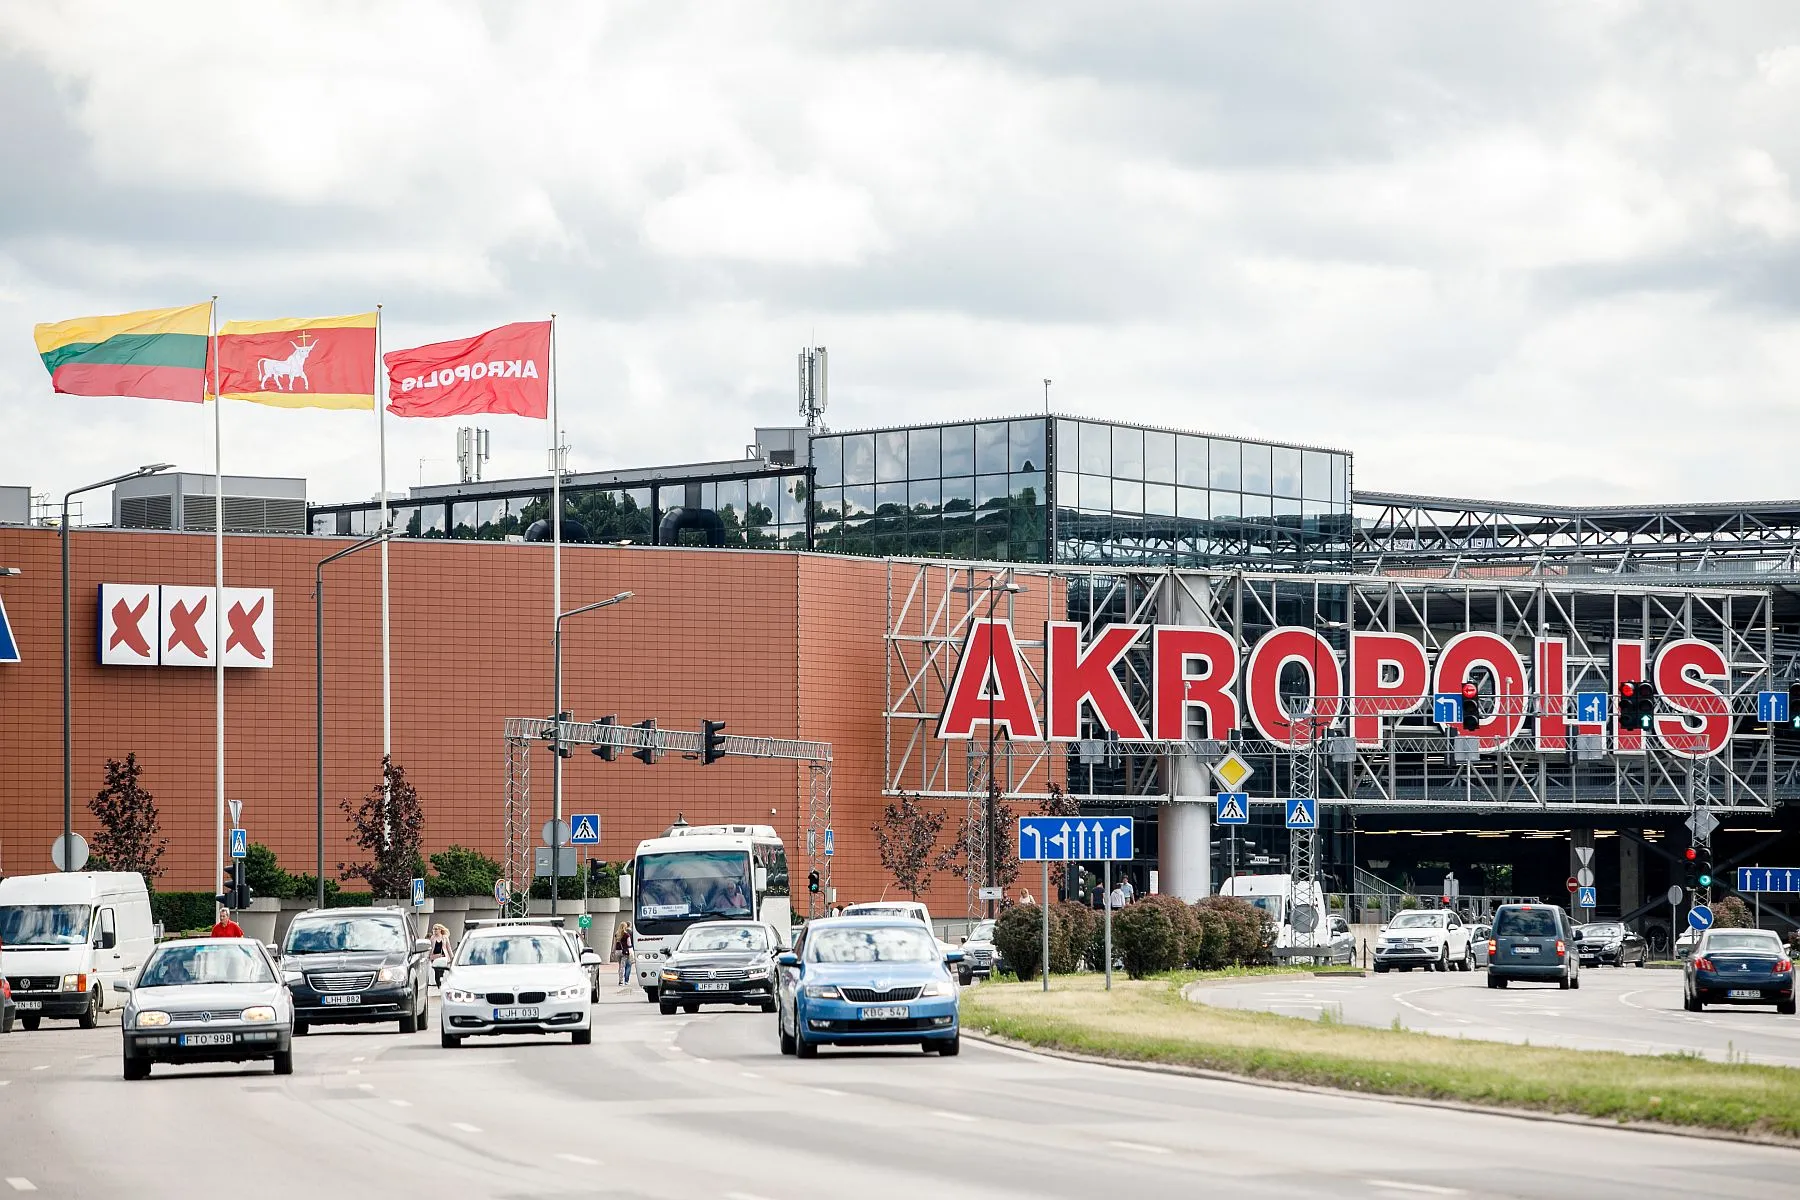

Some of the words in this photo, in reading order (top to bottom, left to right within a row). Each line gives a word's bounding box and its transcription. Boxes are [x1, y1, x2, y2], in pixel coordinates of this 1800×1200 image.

[936, 616, 1734, 759] AKROPOLIS
[325, 995, 342, 1004] LHH
[346, 995, 360, 1003] 882
[498, 1008, 517, 1018] LJH
[522, 1008, 537, 1017] 033
[889, 1007, 907, 1016] 547
[186, 1034, 208, 1044] FTO
[213, 1033, 232, 1043] 998
